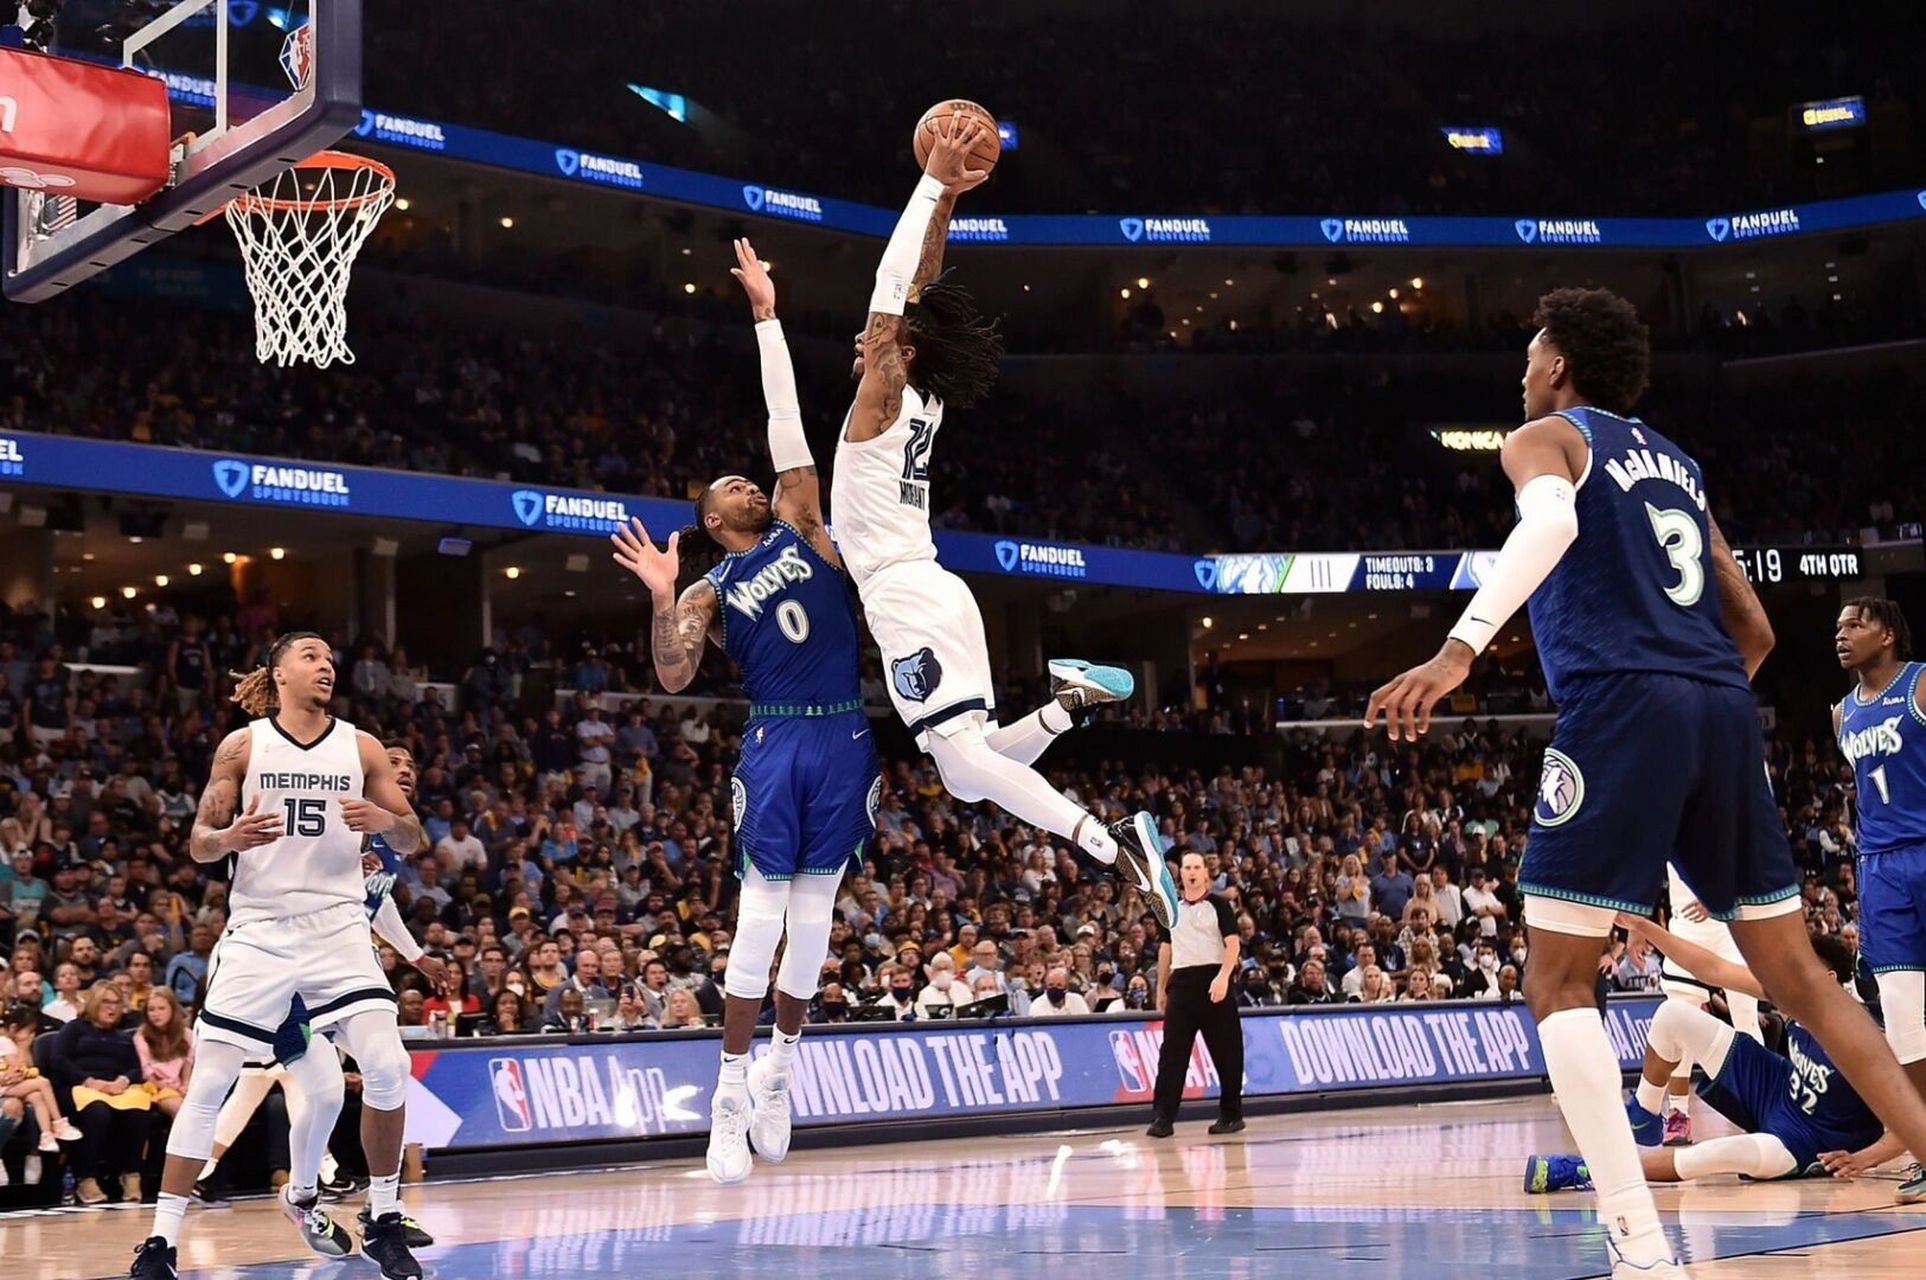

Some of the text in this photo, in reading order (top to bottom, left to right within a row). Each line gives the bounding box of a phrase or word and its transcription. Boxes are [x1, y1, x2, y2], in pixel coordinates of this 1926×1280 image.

[376, 114, 444, 141] FANDUEL
[580, 153, 642, 179] FANDUEL
[766, 190, 821, 213] FANDUEL
[948, 218, 1007, 233] ANDUEL
[1145, 219, 1210, 233] FANDUEL
[1344, 220, 1408, 235] FANDUEL
[1539, 220, 1600, 236] FANDUEL
[1732, 209, 1799, 230] FANDUEL
[252, 465, 348, 494] FANDUEL
[253, 485, 349, 507] SPORTSBOOK
[545, 495, 630, 521] FANDUEL
[546, 514, 629, 533] SPORTSBOO
[1020, 544, 1085, 566] FANDUEL
[1365, 557, 1424, 573] TIMEOUTS:
[1644, 501, 1704, 606] 3
[1800, 554, 1858, 577] 4TH QTR
[725, 542, 813, 622] WOLVES
[1365, 574, 1414, 590] FOULS: 4
[775, 598, 810, 644] 0
[1841, 714, 1904, 772] WOLVES
[260, 773, 351, 791] MEMPHIS
[1867, 763, 1890, 804] 1
[284, 799, 326, 836] 15
[1279, 1015, 1437, 1085] DOWNLOAD
[1424, 1012, 1487, 1075] THE
[1474, 1010, 1530, 1073] APP
[926, 1034, 1003, 1108] THE
[995, 1031, 1073, 1104] APP
[524, 1055, 666, 1133] NBA App
